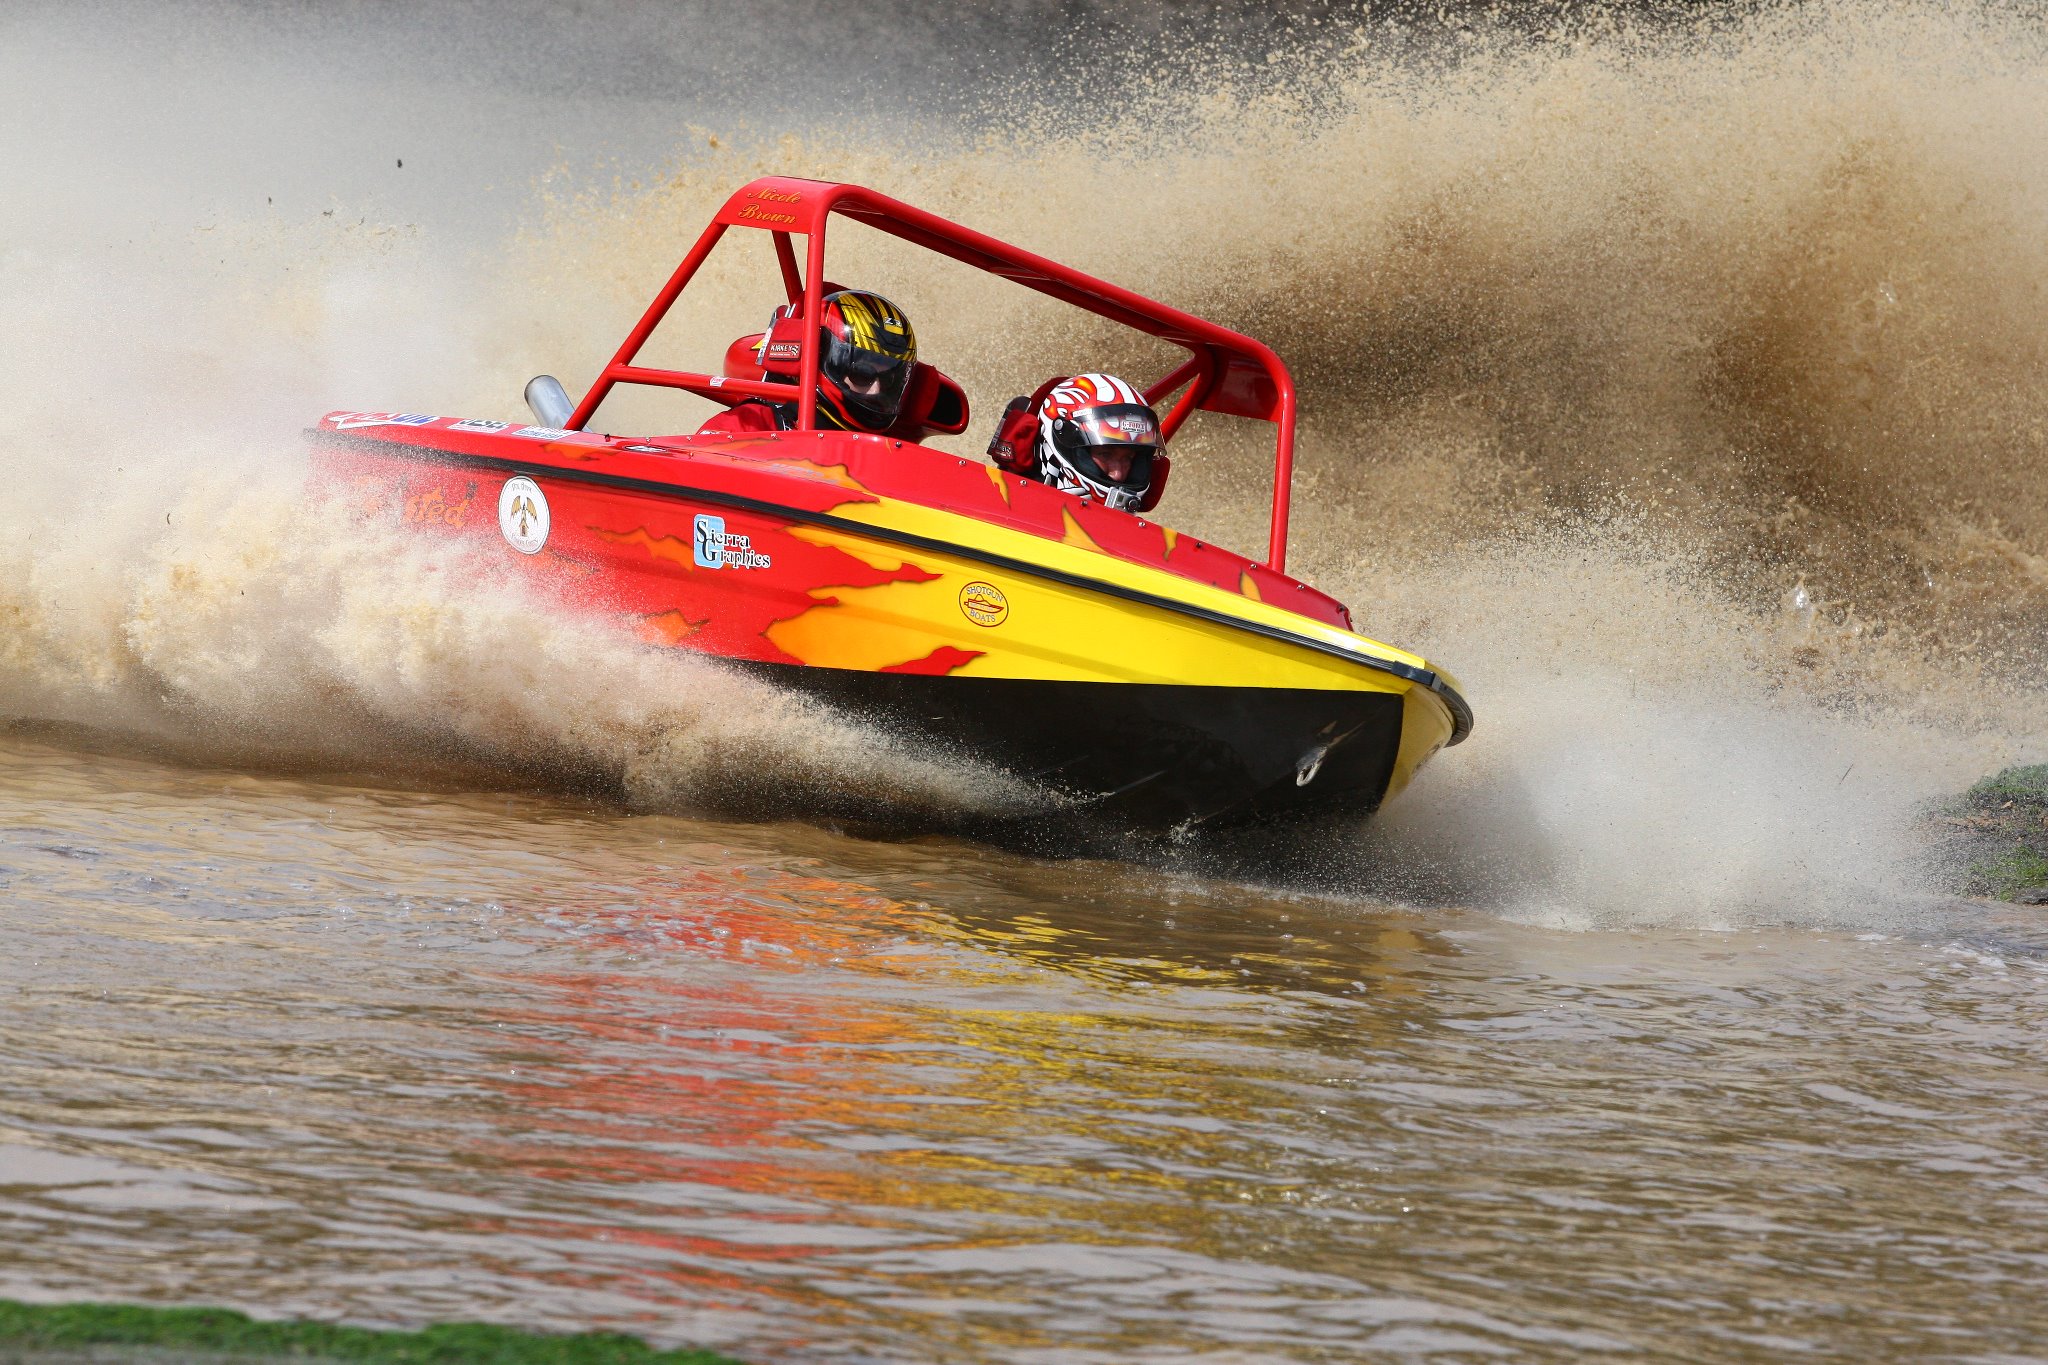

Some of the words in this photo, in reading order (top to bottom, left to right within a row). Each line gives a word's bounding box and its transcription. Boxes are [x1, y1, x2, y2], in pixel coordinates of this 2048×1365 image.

[747, 187, 801, 204] Nicole
[738, 203, 796, 224] Brown
[770, 344, 792, 352] KIRKEY
[696, 519, 751, 548] Sierra
[702, 539, 771, 569] Graphics
[965, 585, 1004, 603] SHOTGUN
[969, 609, 996, 623] BOATS
